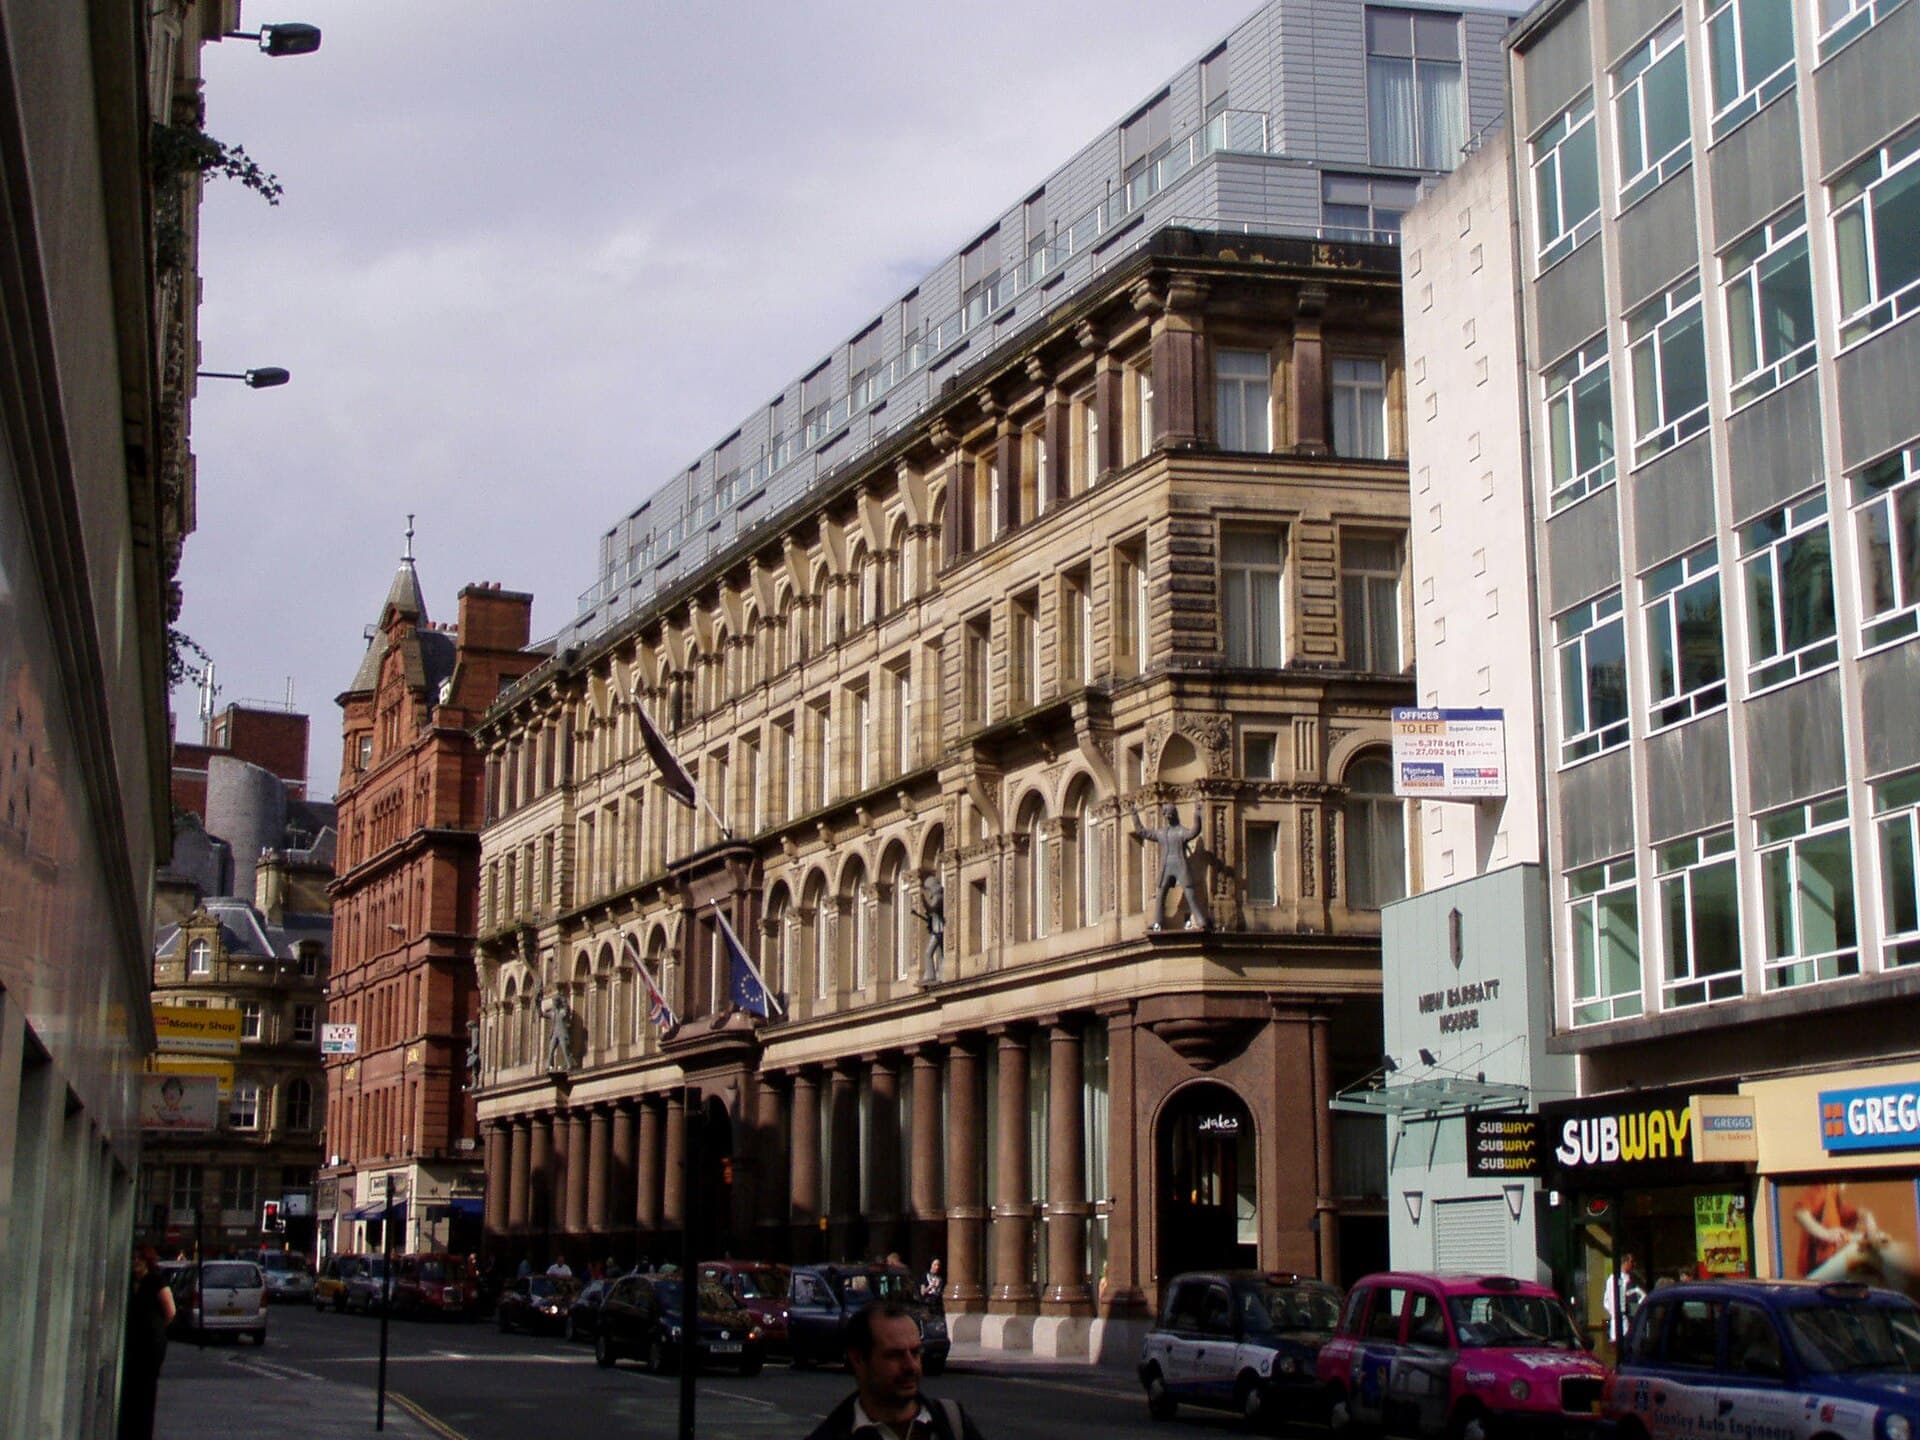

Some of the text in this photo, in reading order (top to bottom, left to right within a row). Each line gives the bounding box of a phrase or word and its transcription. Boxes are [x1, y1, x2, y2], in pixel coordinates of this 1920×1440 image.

[1399, 711, 1440, 720] OFFICES
[1401, 724, 1439, 734] TO LET
[1418, 978, 1500, 1015] NEW BARRATT
[169, 1020, 205, 1031] Money
[208, 1021, 236, 1032] Shop
[1439, 1008, 1480, 1035] HOUSE
[1847, 1093, 1920, 1136] GREG
[1477, 1121, 1535, 1134] SUBWAY
[1713, 1118, 1752, 1129] GREGGS
[1555, 1107, 1691, 1166] SUBWAY
[1477, 1139, 1535, 1152] SUBWAY
[1478, 1156, 1536, 1170] SUBWAY
[1698, 1414, 1726, 1432] Auto
[1729, 1418, 1795, 1440] Engineers
